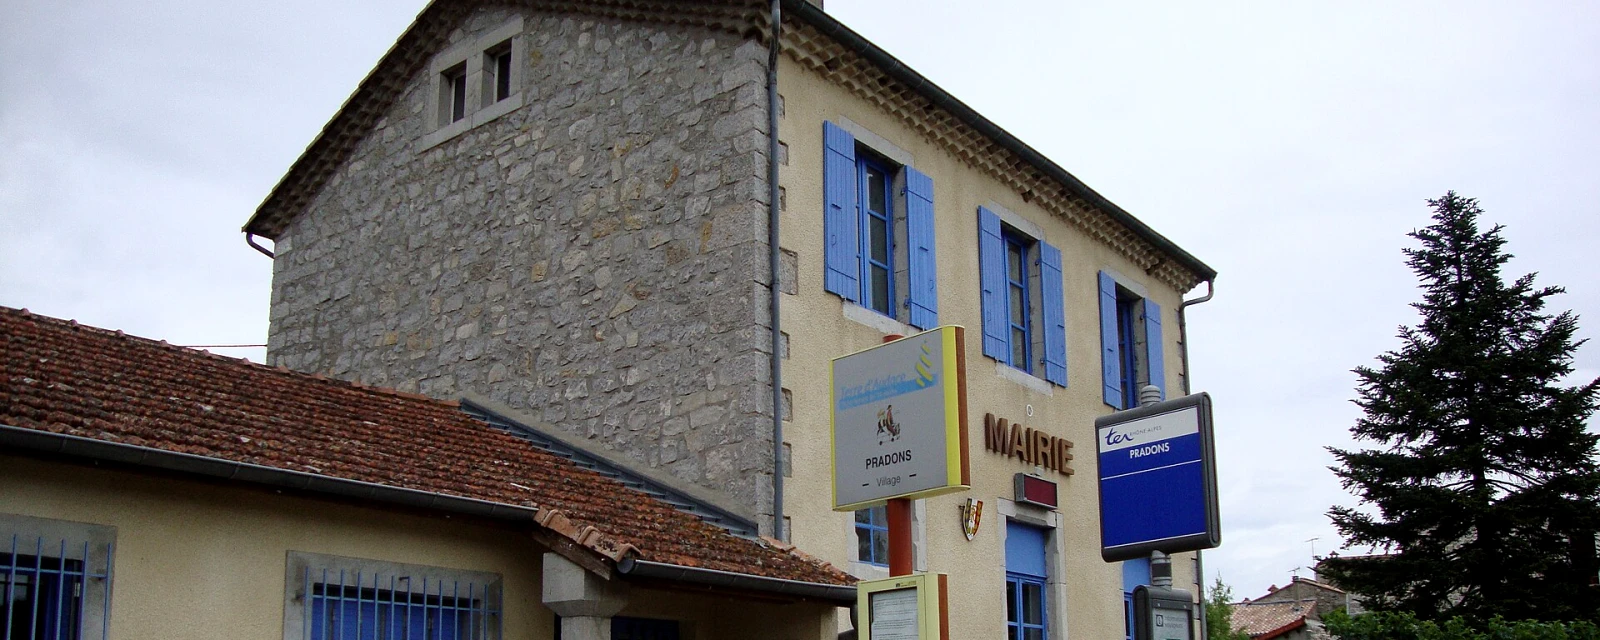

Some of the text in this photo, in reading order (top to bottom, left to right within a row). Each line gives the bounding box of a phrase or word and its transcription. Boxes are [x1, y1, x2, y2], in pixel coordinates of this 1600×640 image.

[984, 412, 1075, 476] MAIRIE
[1105, 428, 1134, 446] ter
[865, 450, 912, 469] PRADONS
[1129, 442, 1170, 459] PRADONS
[876, 476, 901, 487] Village
